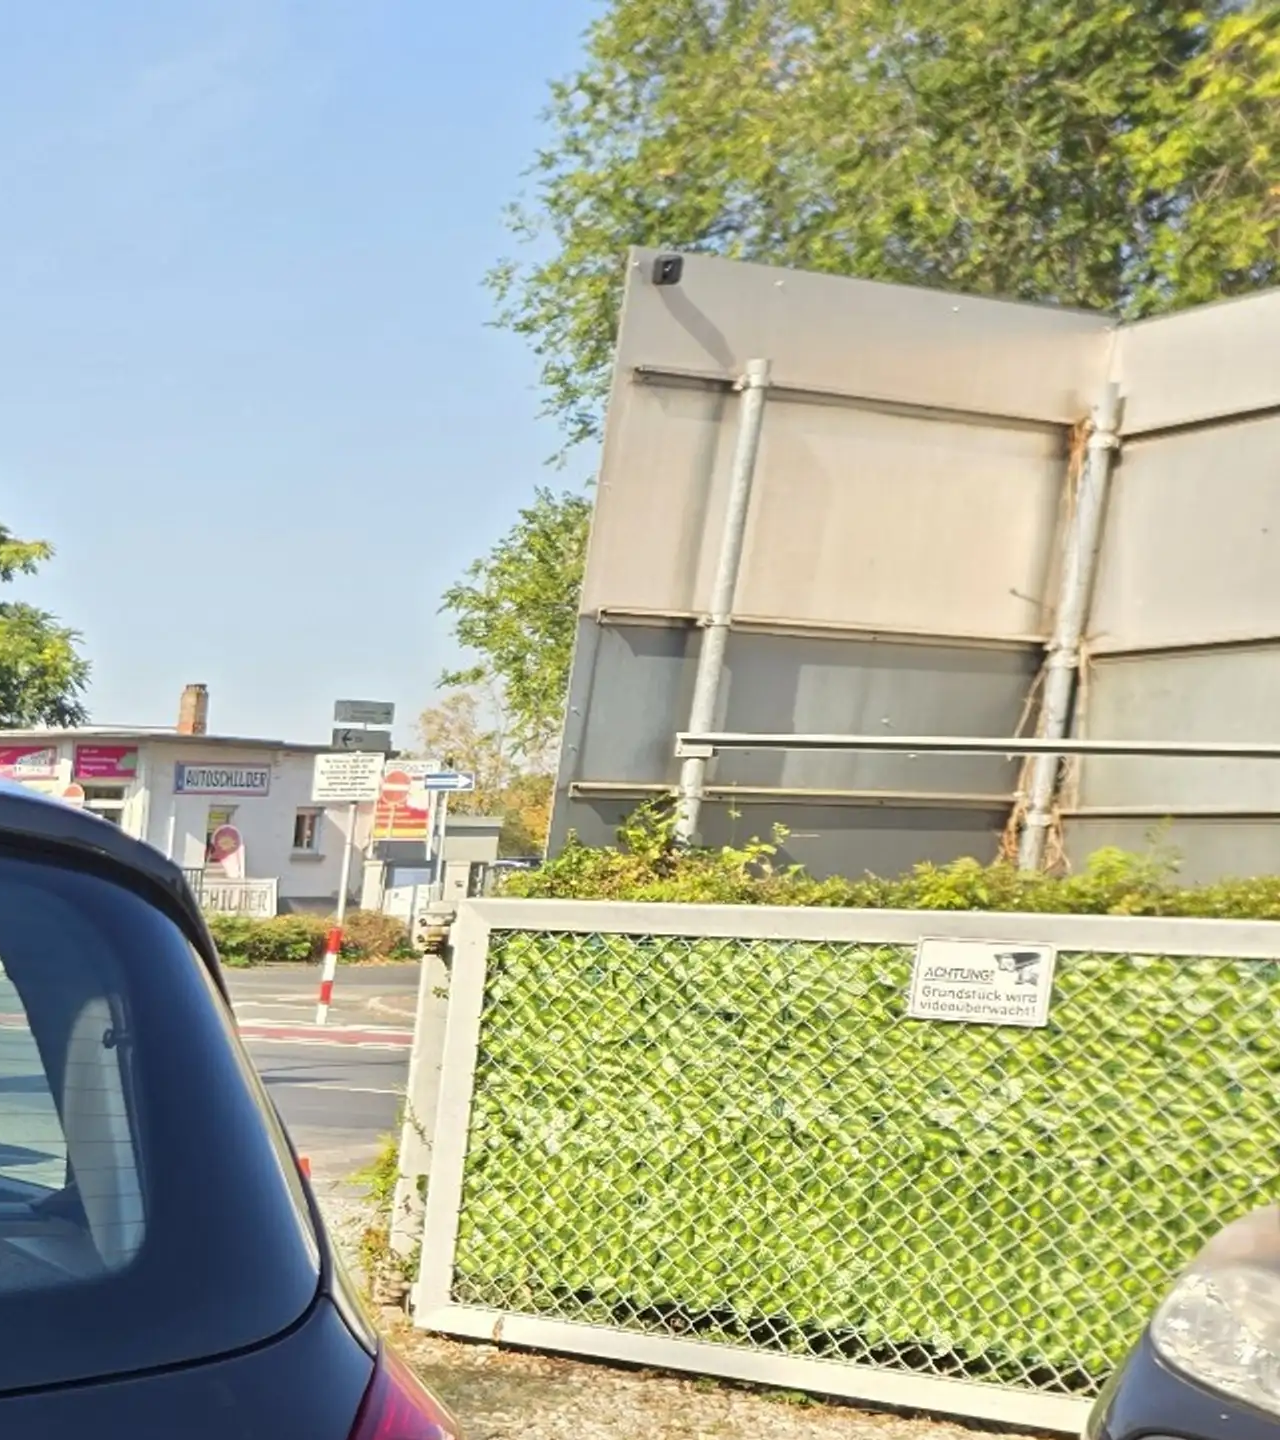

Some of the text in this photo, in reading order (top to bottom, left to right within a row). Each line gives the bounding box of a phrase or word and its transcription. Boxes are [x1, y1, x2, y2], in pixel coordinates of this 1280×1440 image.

[185, 769, 268, 788] AUTOSCHILDER
[924, 966, 995, 982] ACHTUNG!
[921, 985, 1038, 1004] Grundstück wird
